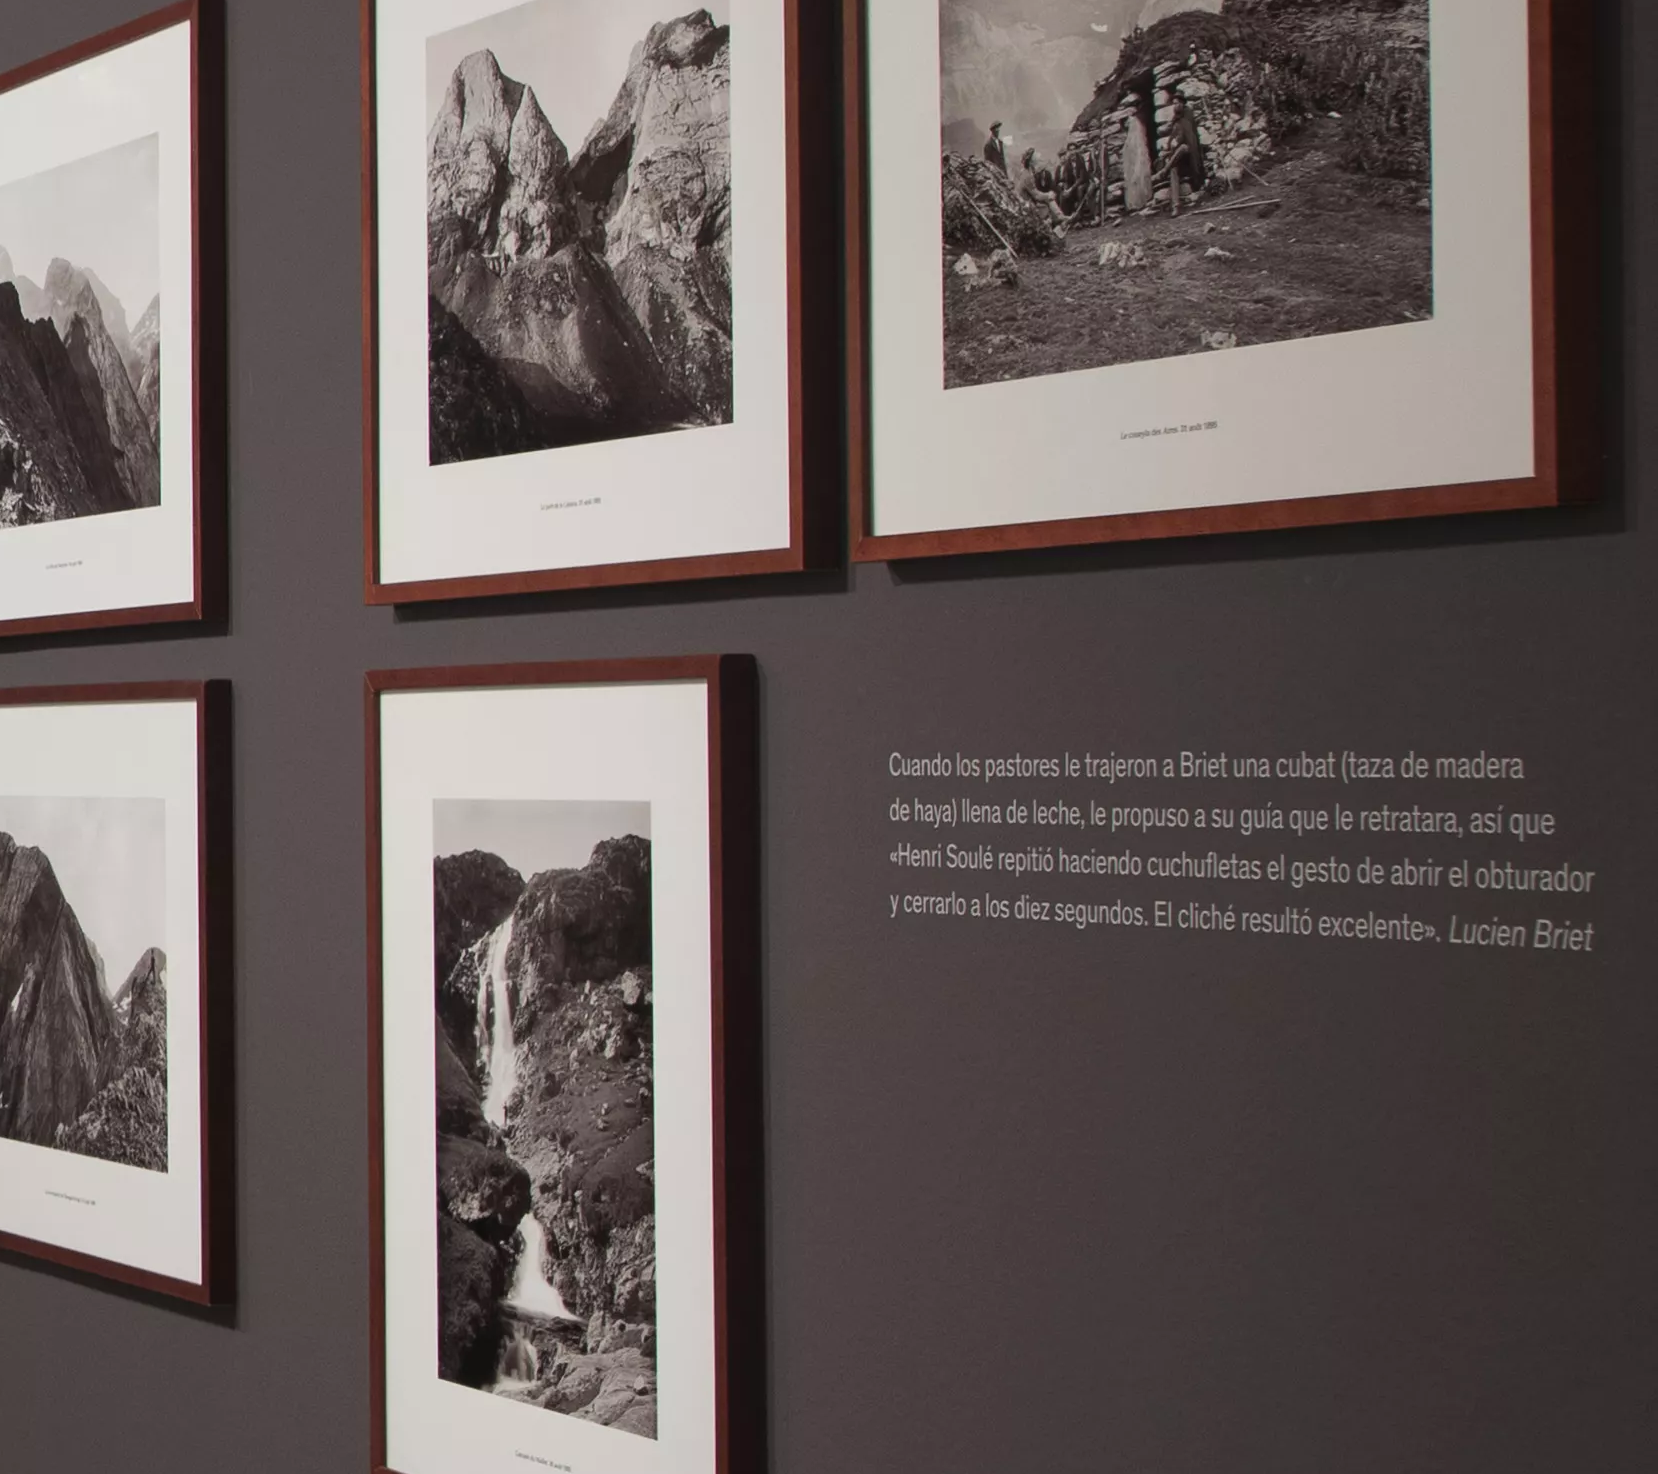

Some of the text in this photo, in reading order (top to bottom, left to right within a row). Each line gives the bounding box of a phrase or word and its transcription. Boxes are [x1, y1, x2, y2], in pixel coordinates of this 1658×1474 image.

[888, 750, 1525, 784] Cuando los pastores le trajeron a Briet una cubat (taza de madera
[889, 797, 1556, 842] de haya) llena de leche, le propuso a su guía que le retratara, así que
[889, 842, 1596, 893] «Henri Soulé repitió haciendo cuchufletas el gesto de abrir el obturador
[889, 891, 1595, 952] y cerrarlo a los diez segundos. El cliché resultó excelente». Lucien Briet
